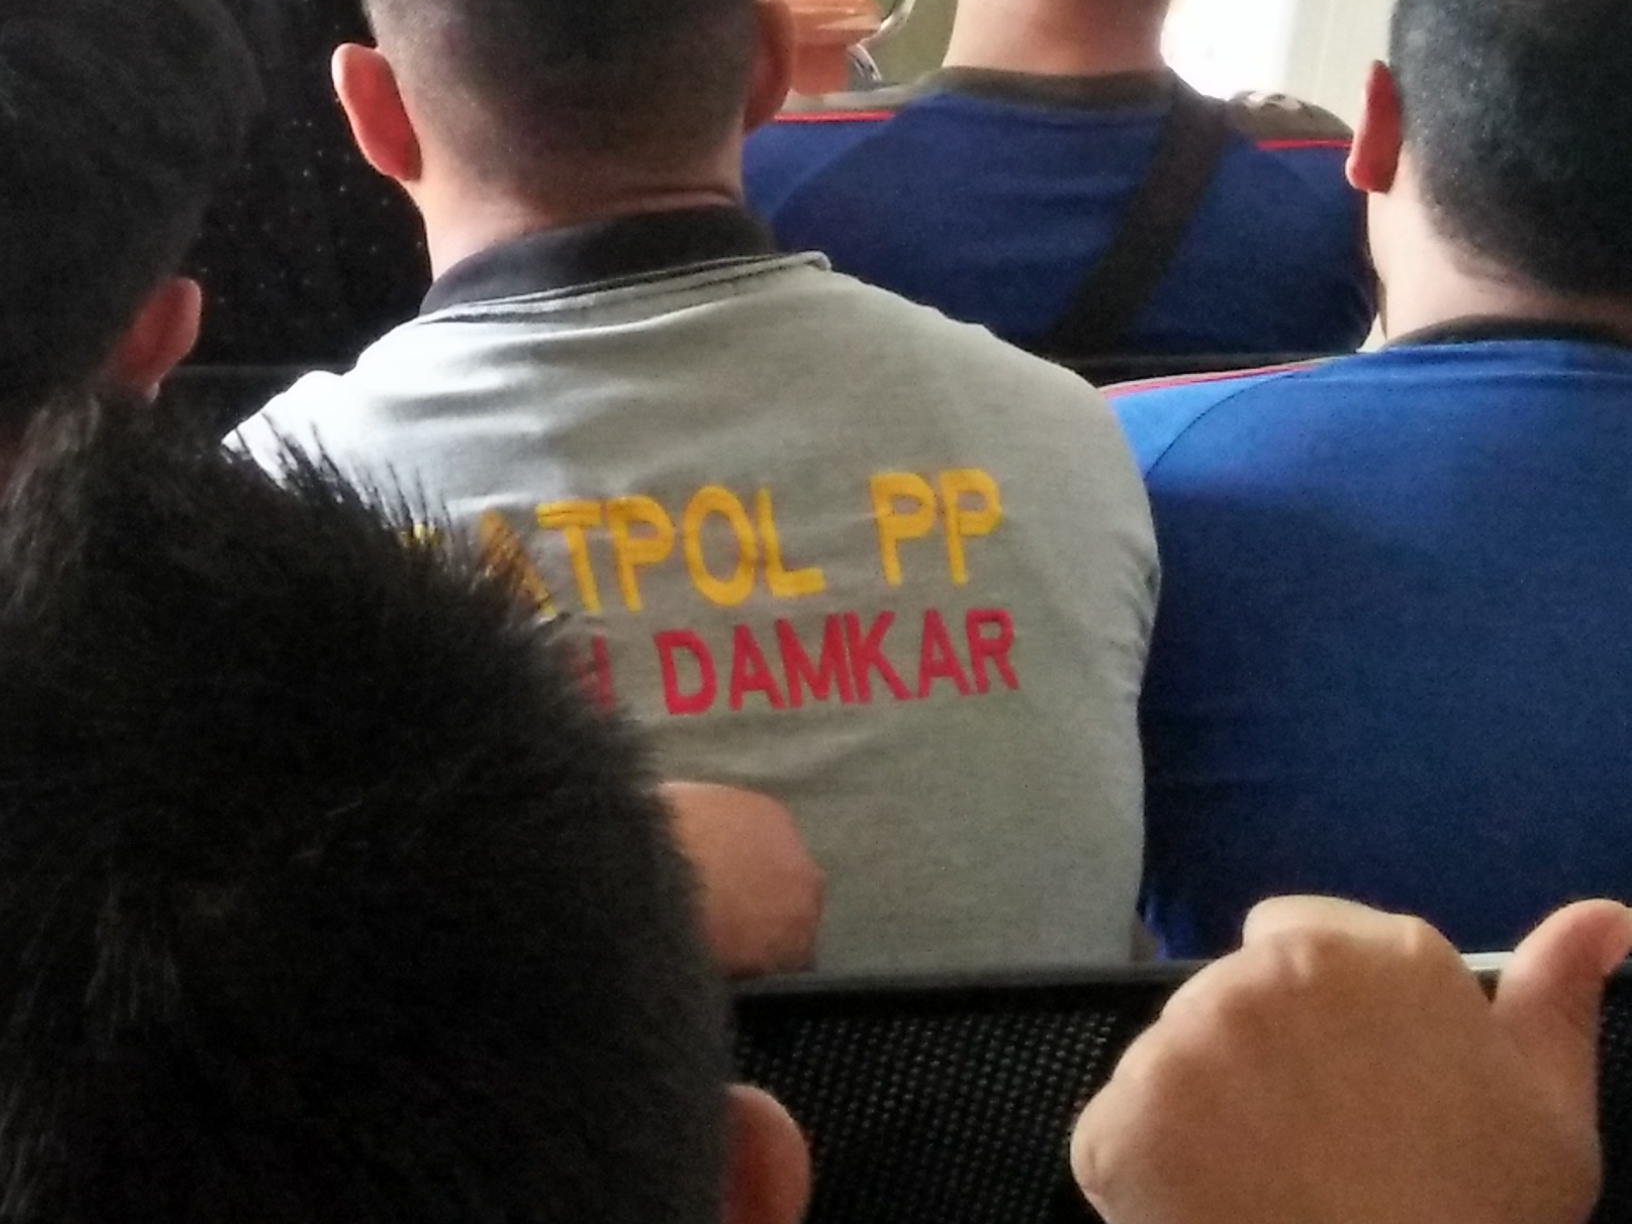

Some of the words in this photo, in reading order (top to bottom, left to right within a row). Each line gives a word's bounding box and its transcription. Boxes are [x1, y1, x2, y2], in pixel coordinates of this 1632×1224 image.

[400, 484, 827, 617] ATPOL
[870, 467, 1004, 587] PP
[654, 607, 1020, 716] DAMKAR
